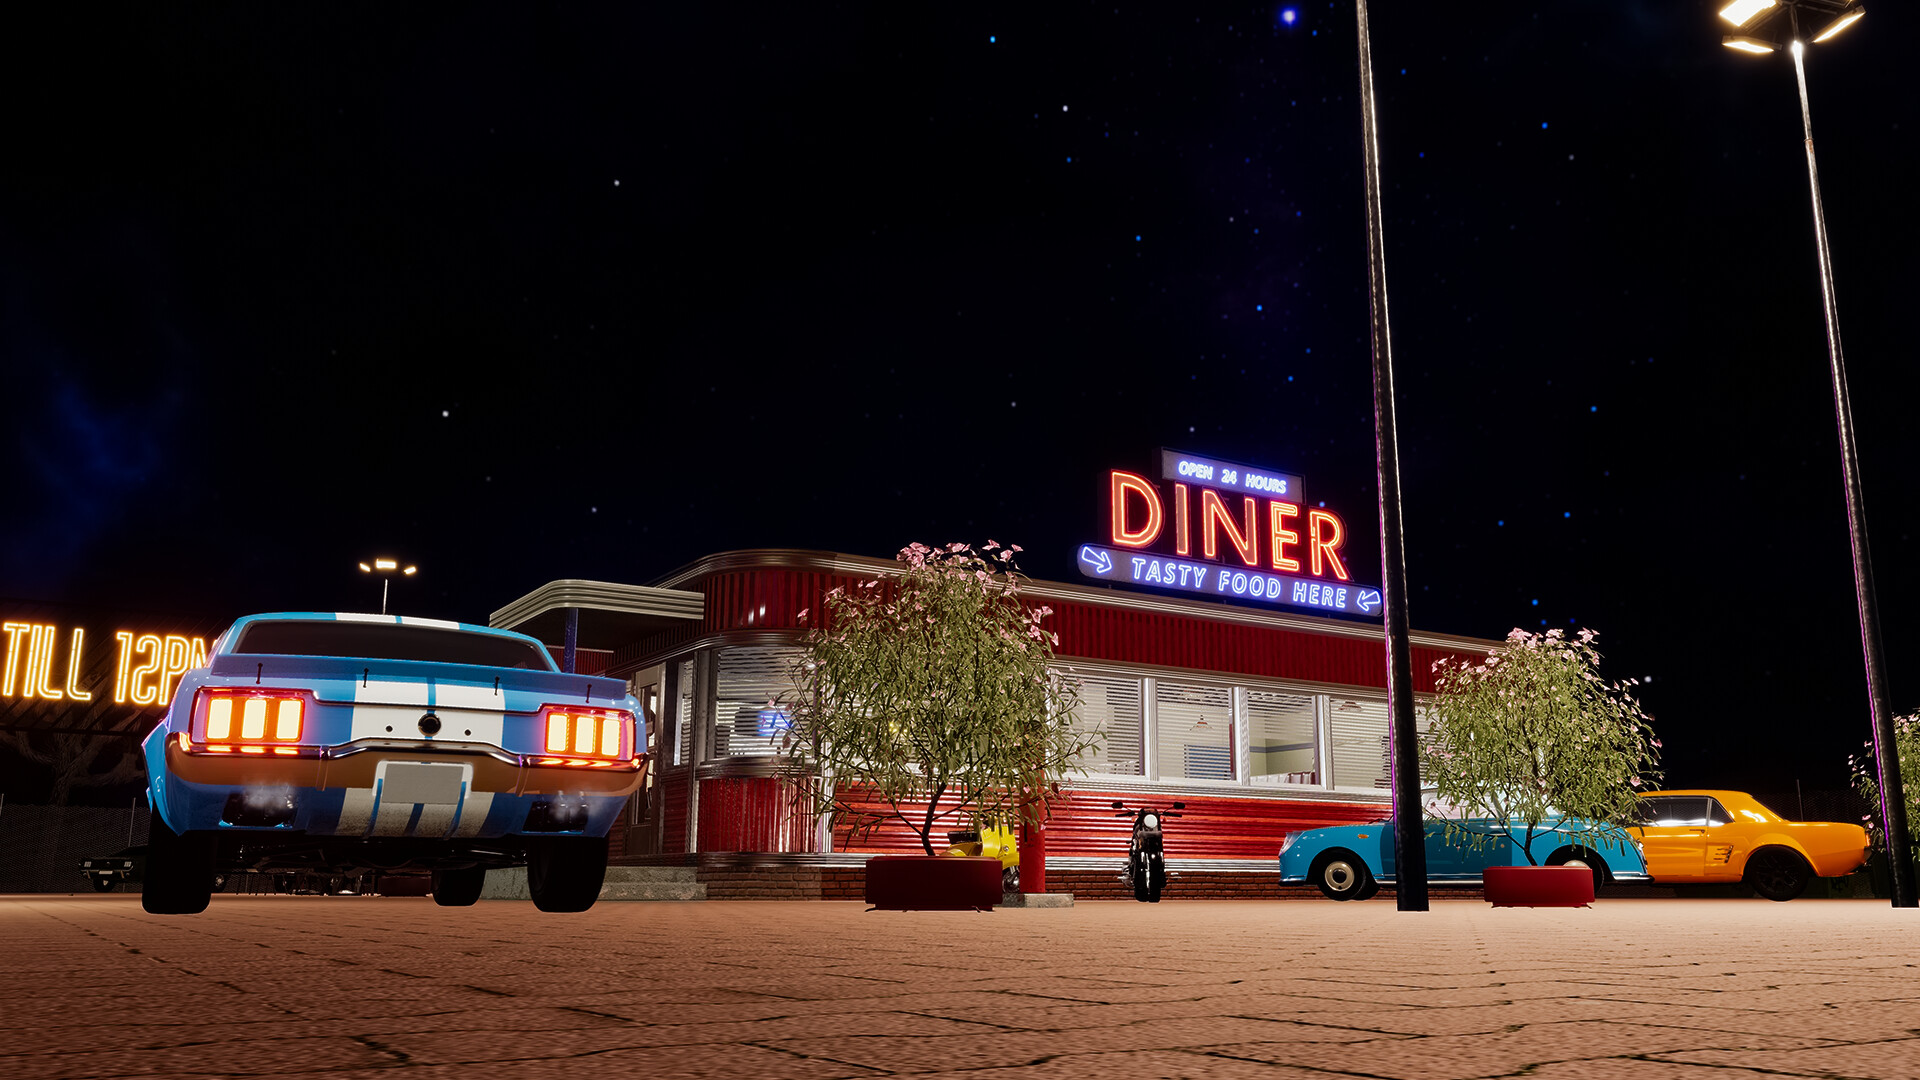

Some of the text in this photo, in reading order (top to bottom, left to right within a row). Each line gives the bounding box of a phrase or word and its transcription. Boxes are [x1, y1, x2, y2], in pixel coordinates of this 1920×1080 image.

[1178, 460, 1287, 494] OPEN 24 HOURS
[1111, 471, 1348, 580] DINER
[1132, 557, 1347, 608] TASTY FOOD HERE
[3, 622, 92, 701] TILL
